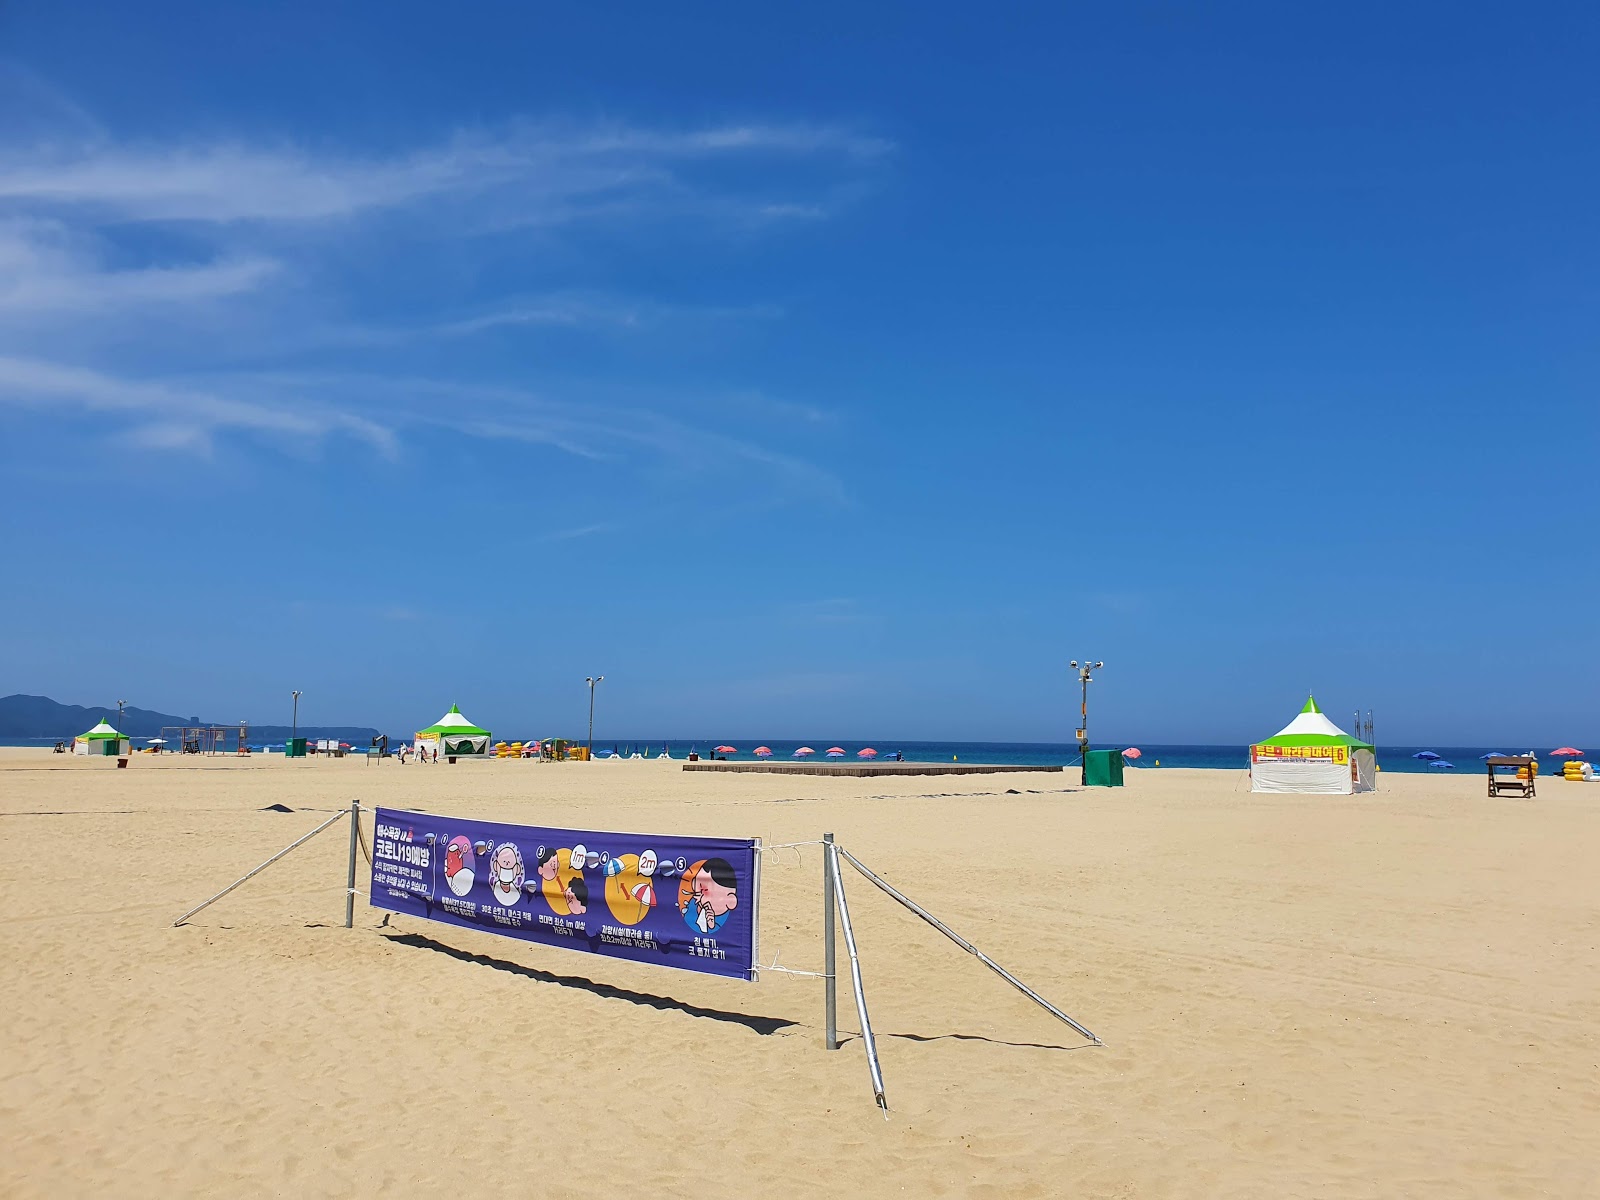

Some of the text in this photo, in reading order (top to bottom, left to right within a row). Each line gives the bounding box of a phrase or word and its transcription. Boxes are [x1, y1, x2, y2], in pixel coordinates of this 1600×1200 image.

[1337, 748, 1344, 762] 6
[377, 824, 400, 841] 해수욕장
[376, 839, 430, 868] 코로나19예방
[572, 853, 585, 864] 1m
[640, 856, 656, 869] 2m
[374, 873, 386, 883] 소중한
[386, 875, 397, 886] 추억을
[406, 881, 411, 890] 수
[481, 904, 492, 914] 30초
[508, 908, 521, 919] 마스크
[522, 912, 532, 921] 착용
[554, 917, 564, 926] 최소
[575, 921, 586, 930] 이상
[553, 926, 574, 936] 거리두기
[633, 938, 658, 950] 거리두기
[694, 936, 701, 946] 침
[688, 946, 695, 956] 코
[712, 949, 726, 960] 않기
